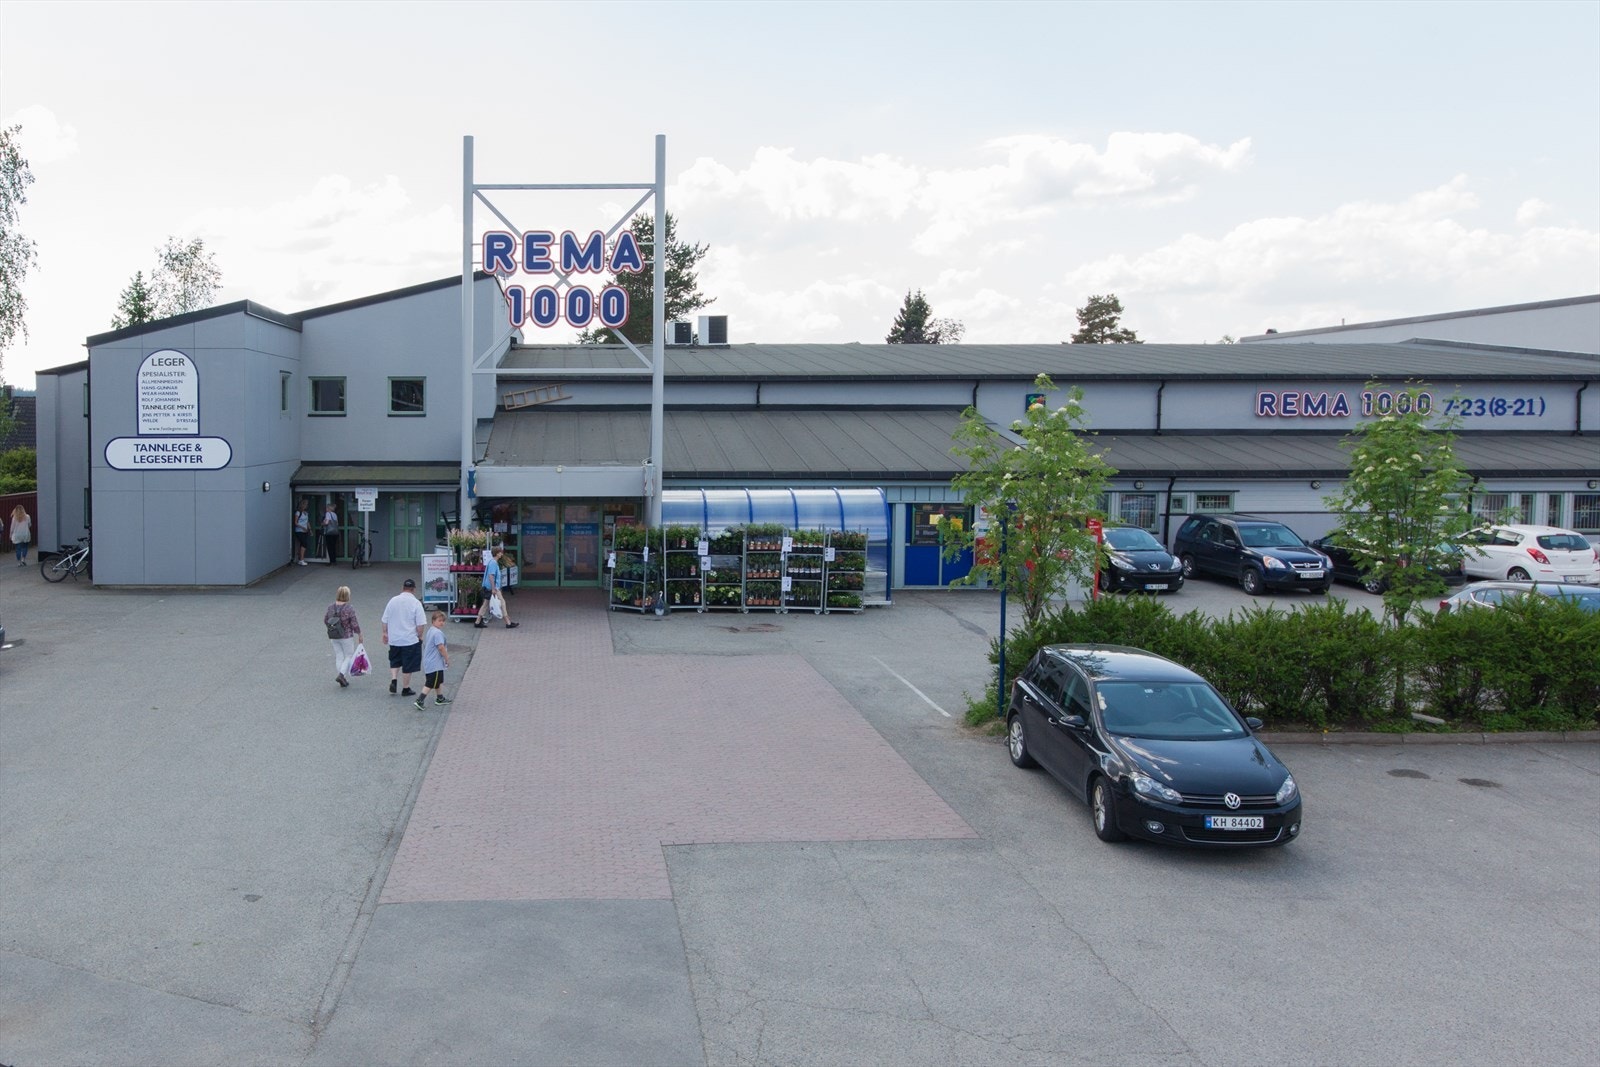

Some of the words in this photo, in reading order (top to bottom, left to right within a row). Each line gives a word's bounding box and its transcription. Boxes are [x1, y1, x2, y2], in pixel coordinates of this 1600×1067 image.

[483, 230, 645, 274] REMA
[505, 285, 630, 328] 1000
[151, 358, 185, 366] LEGER
[1256, 390, 1351, 417] REMA
[1361, 390, 1433, 417] 1000
[134, 444, 192, 452] TANNLEGE
[194, 444, 203, 452] &
[133, 455, 203, 463] LEGESENTER
[1213, 818, 1227, 827] KH
[1231, 818, 1262, 827] 84402
